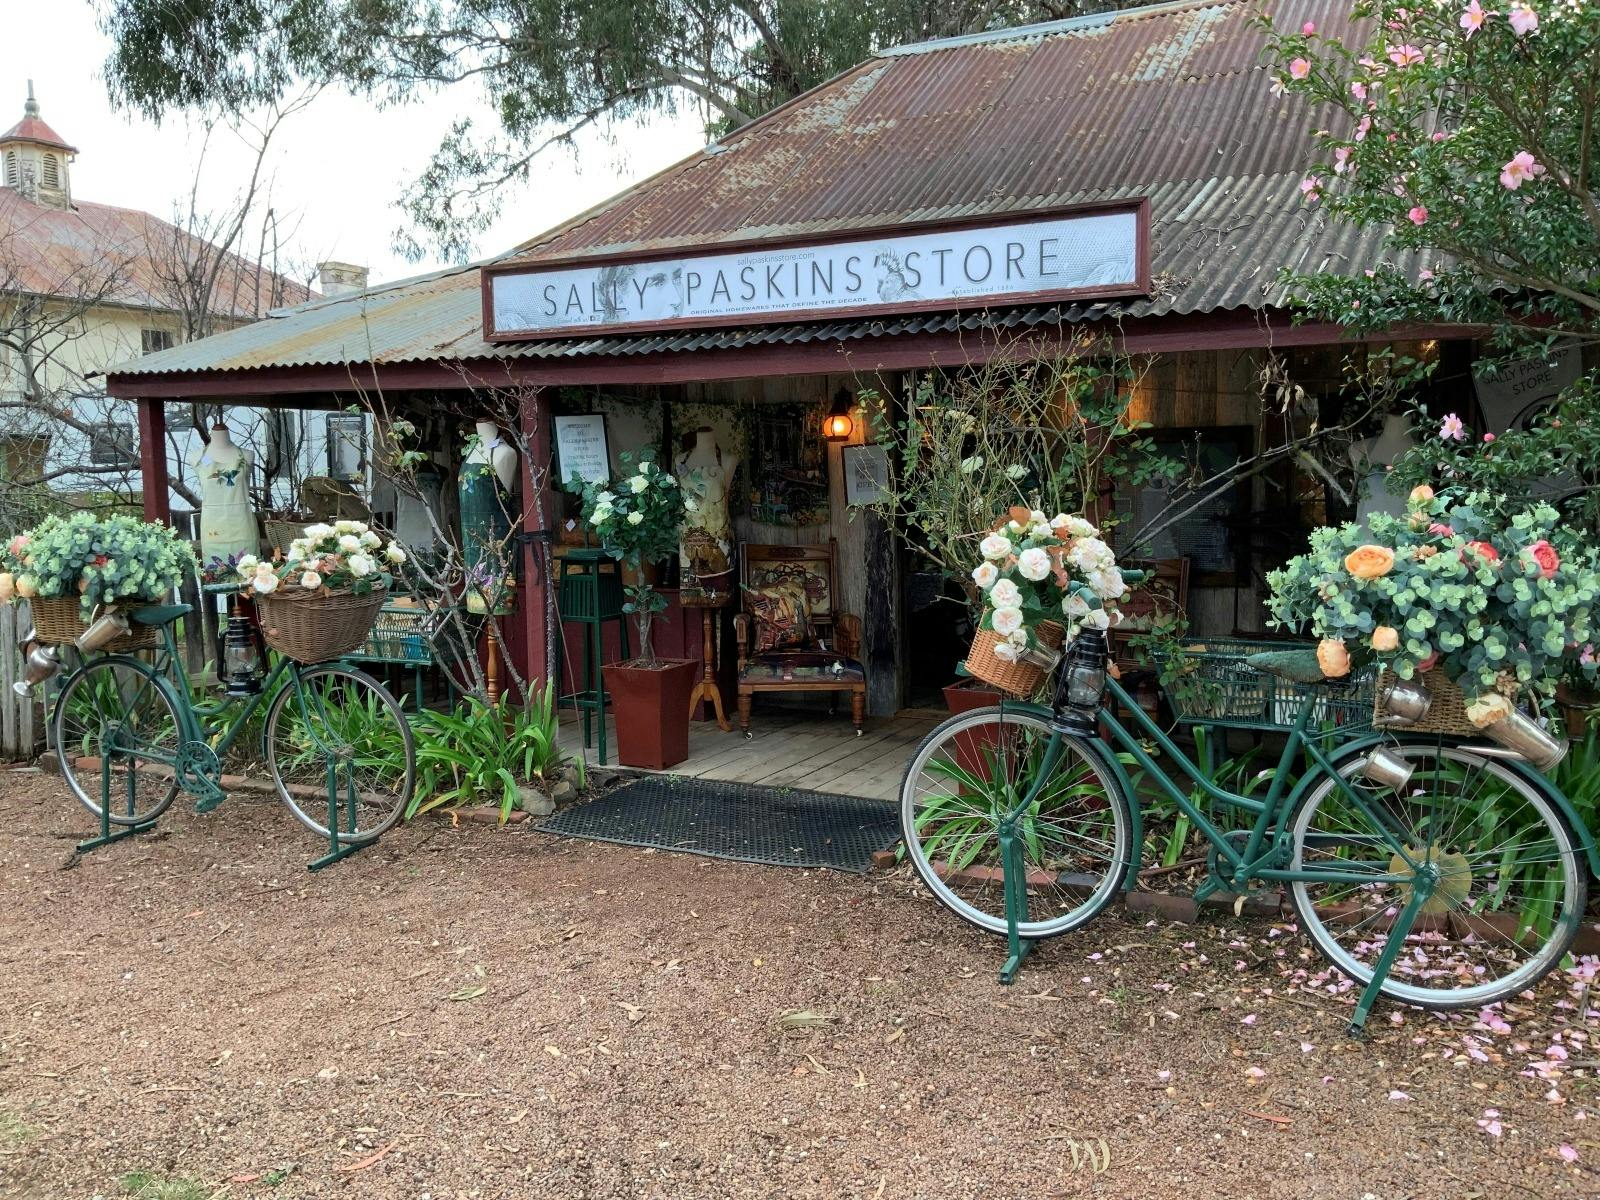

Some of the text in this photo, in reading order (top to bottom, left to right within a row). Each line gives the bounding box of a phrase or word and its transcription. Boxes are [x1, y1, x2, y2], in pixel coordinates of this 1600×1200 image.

[737, 252, 815, 266] sallypaskinsstore.com
[543, 276, 650, 316] SALLY
[904, 238, 1059, 288] STORE
[1512, 370, 1552, 395] STORE
